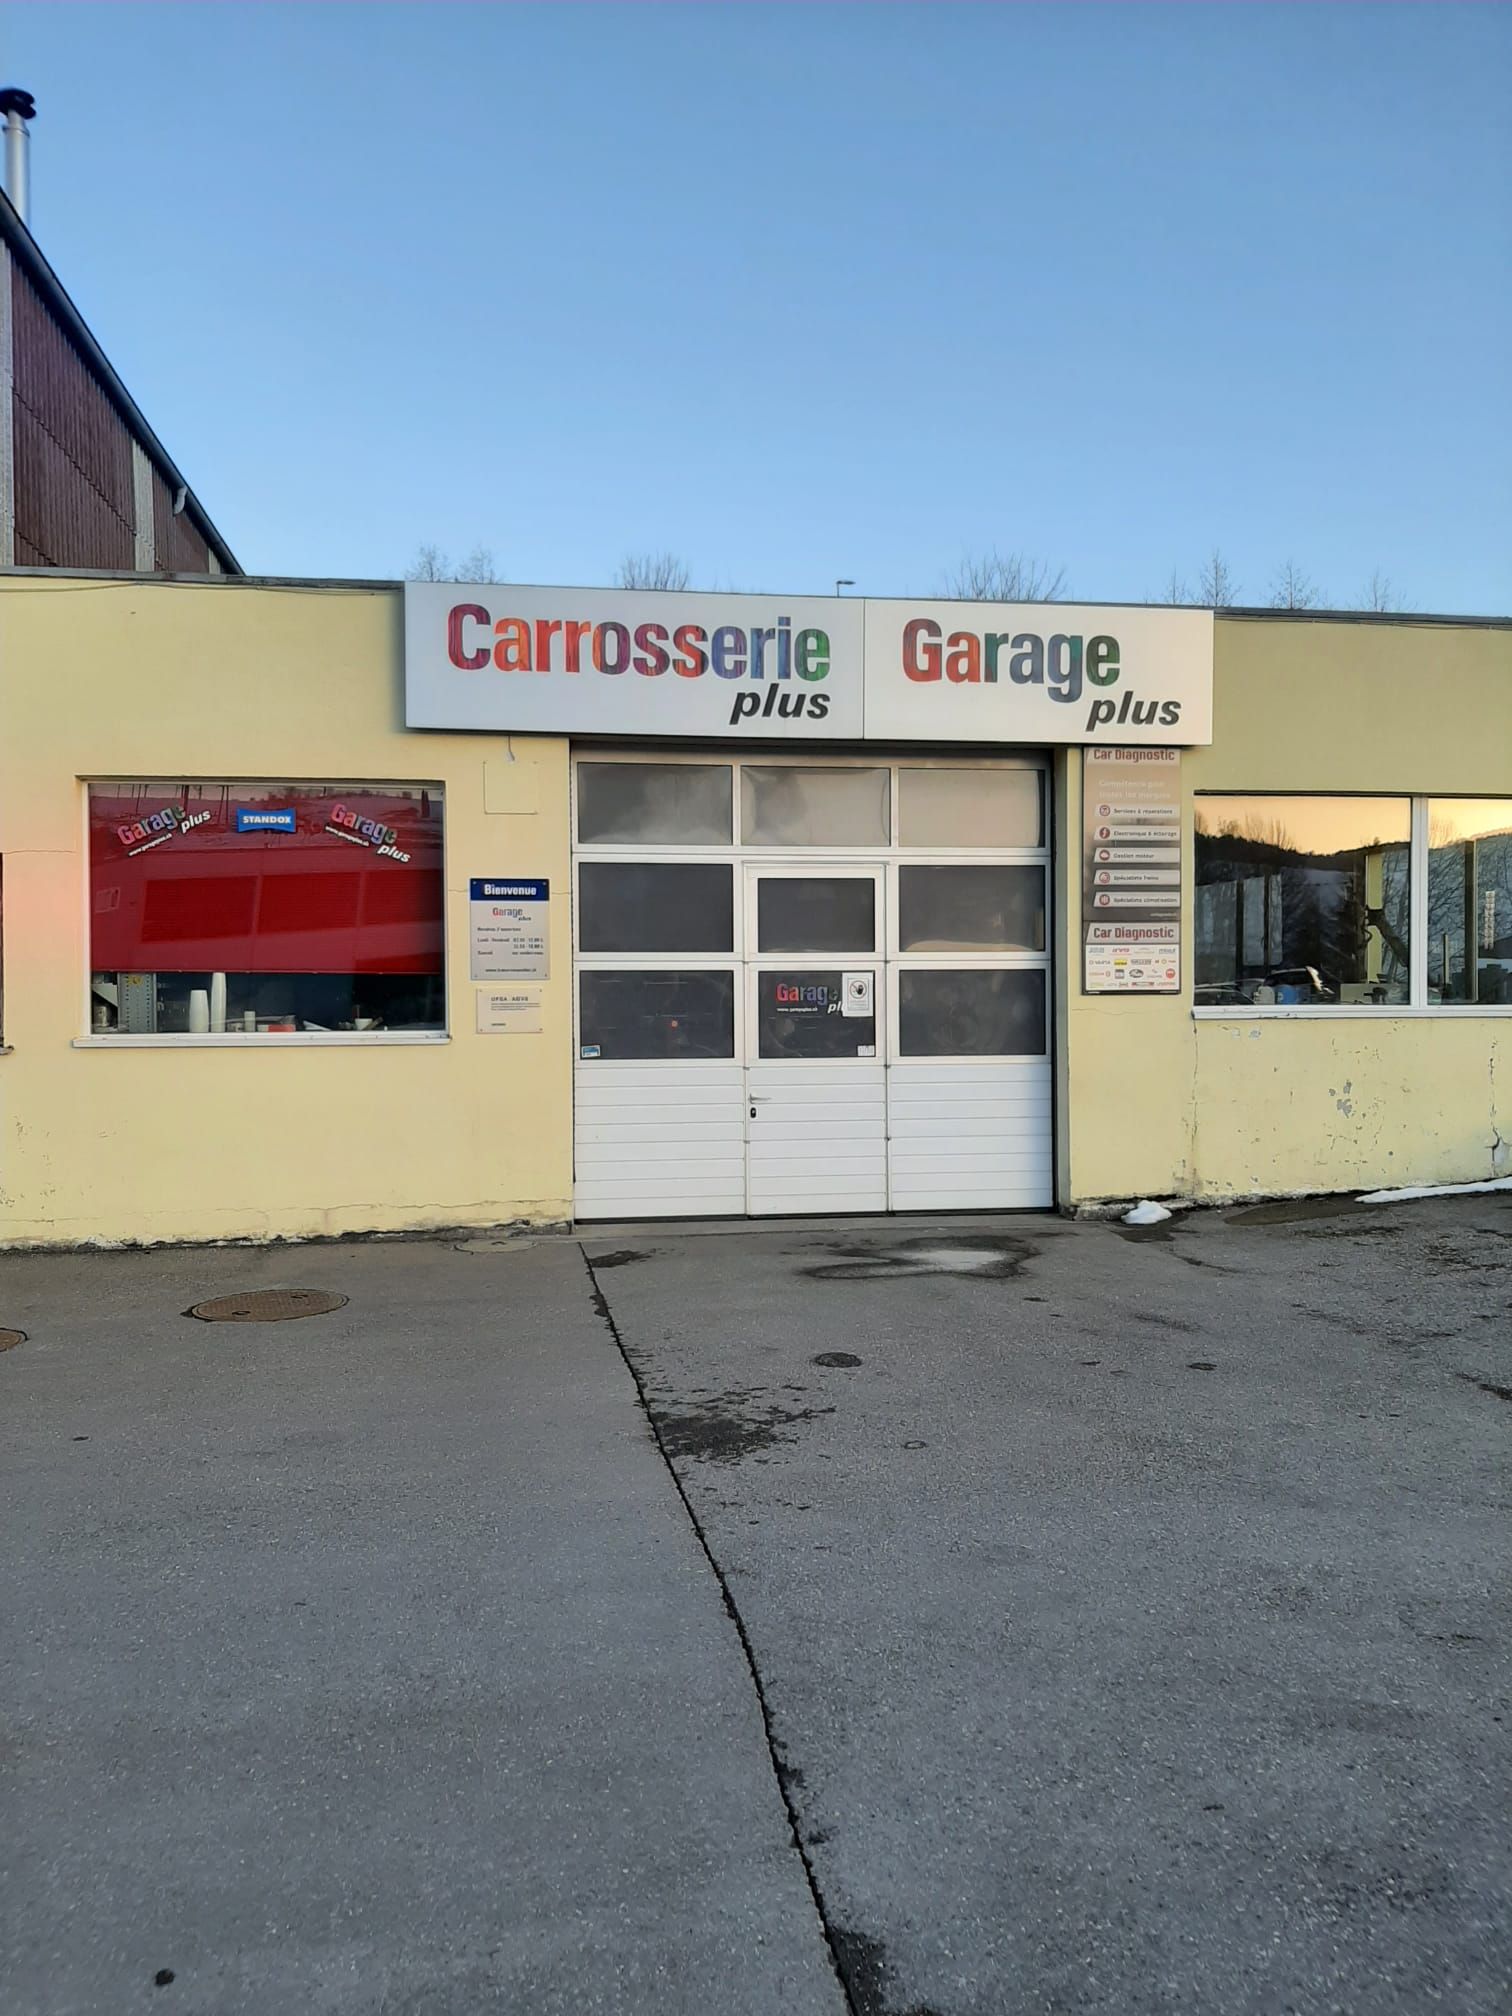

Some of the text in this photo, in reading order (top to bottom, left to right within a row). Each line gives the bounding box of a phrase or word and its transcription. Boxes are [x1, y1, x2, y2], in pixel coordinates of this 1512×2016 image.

[447, 603, 831, 682] Carrosserie
[902, 617, 1121, 704] Garage
[729, 683, 831, 726] plus
[1085, 690, 1182, 732] plus
[1093, 748, 1175, 763] Car Diagnostic
[117, 805, 187, 845] Garage
[181, 809, 212, 834] plus
[243, 815, 292, 824] STANDOX
[331, 803, 398, 845] Garage
[377, 844, 412, 862] plus
[484, 884, 537, 896] Bienvenue
[492, 907, 524, 919] Garage
[1093, 926, 1175, 941] Car Diagnostic
